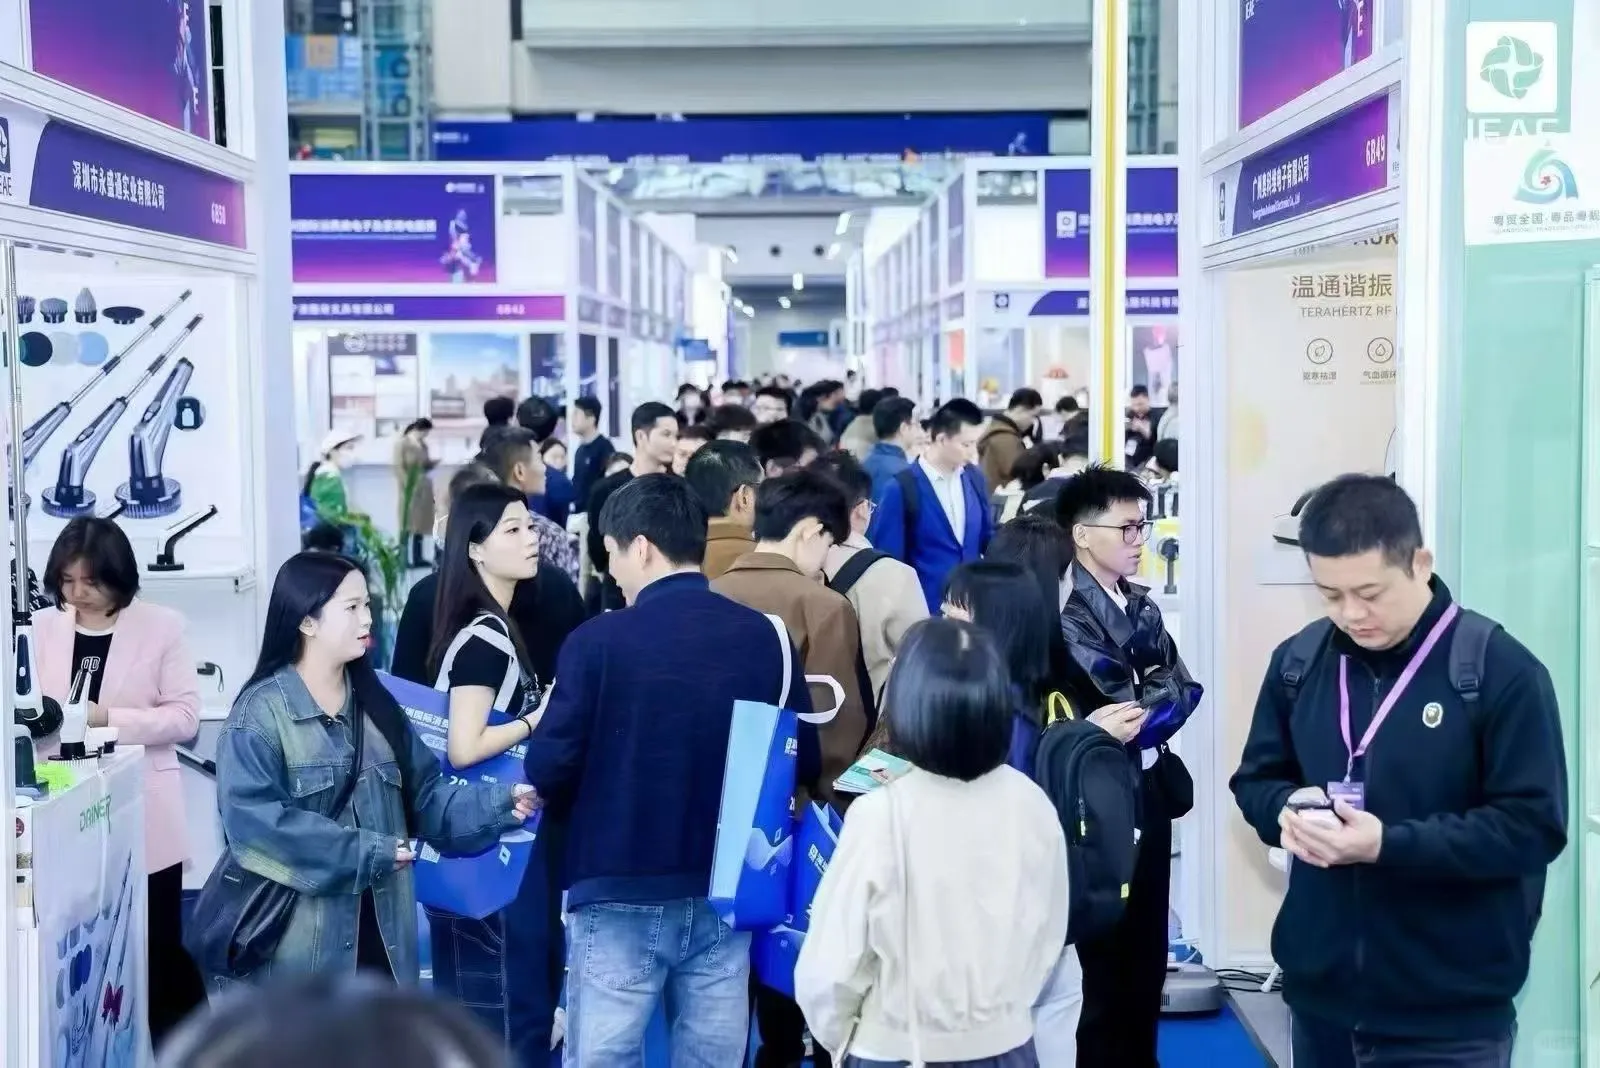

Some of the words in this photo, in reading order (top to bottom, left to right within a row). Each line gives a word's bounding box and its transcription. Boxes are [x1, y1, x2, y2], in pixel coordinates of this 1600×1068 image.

[1365, 134, 1385, 167] 6B49
[1291, 273, 1393, 298] 温通谐振
[1300, 306, 1372, 318] TERAHERTZ
[1376, 305, 1392, 317] RF
